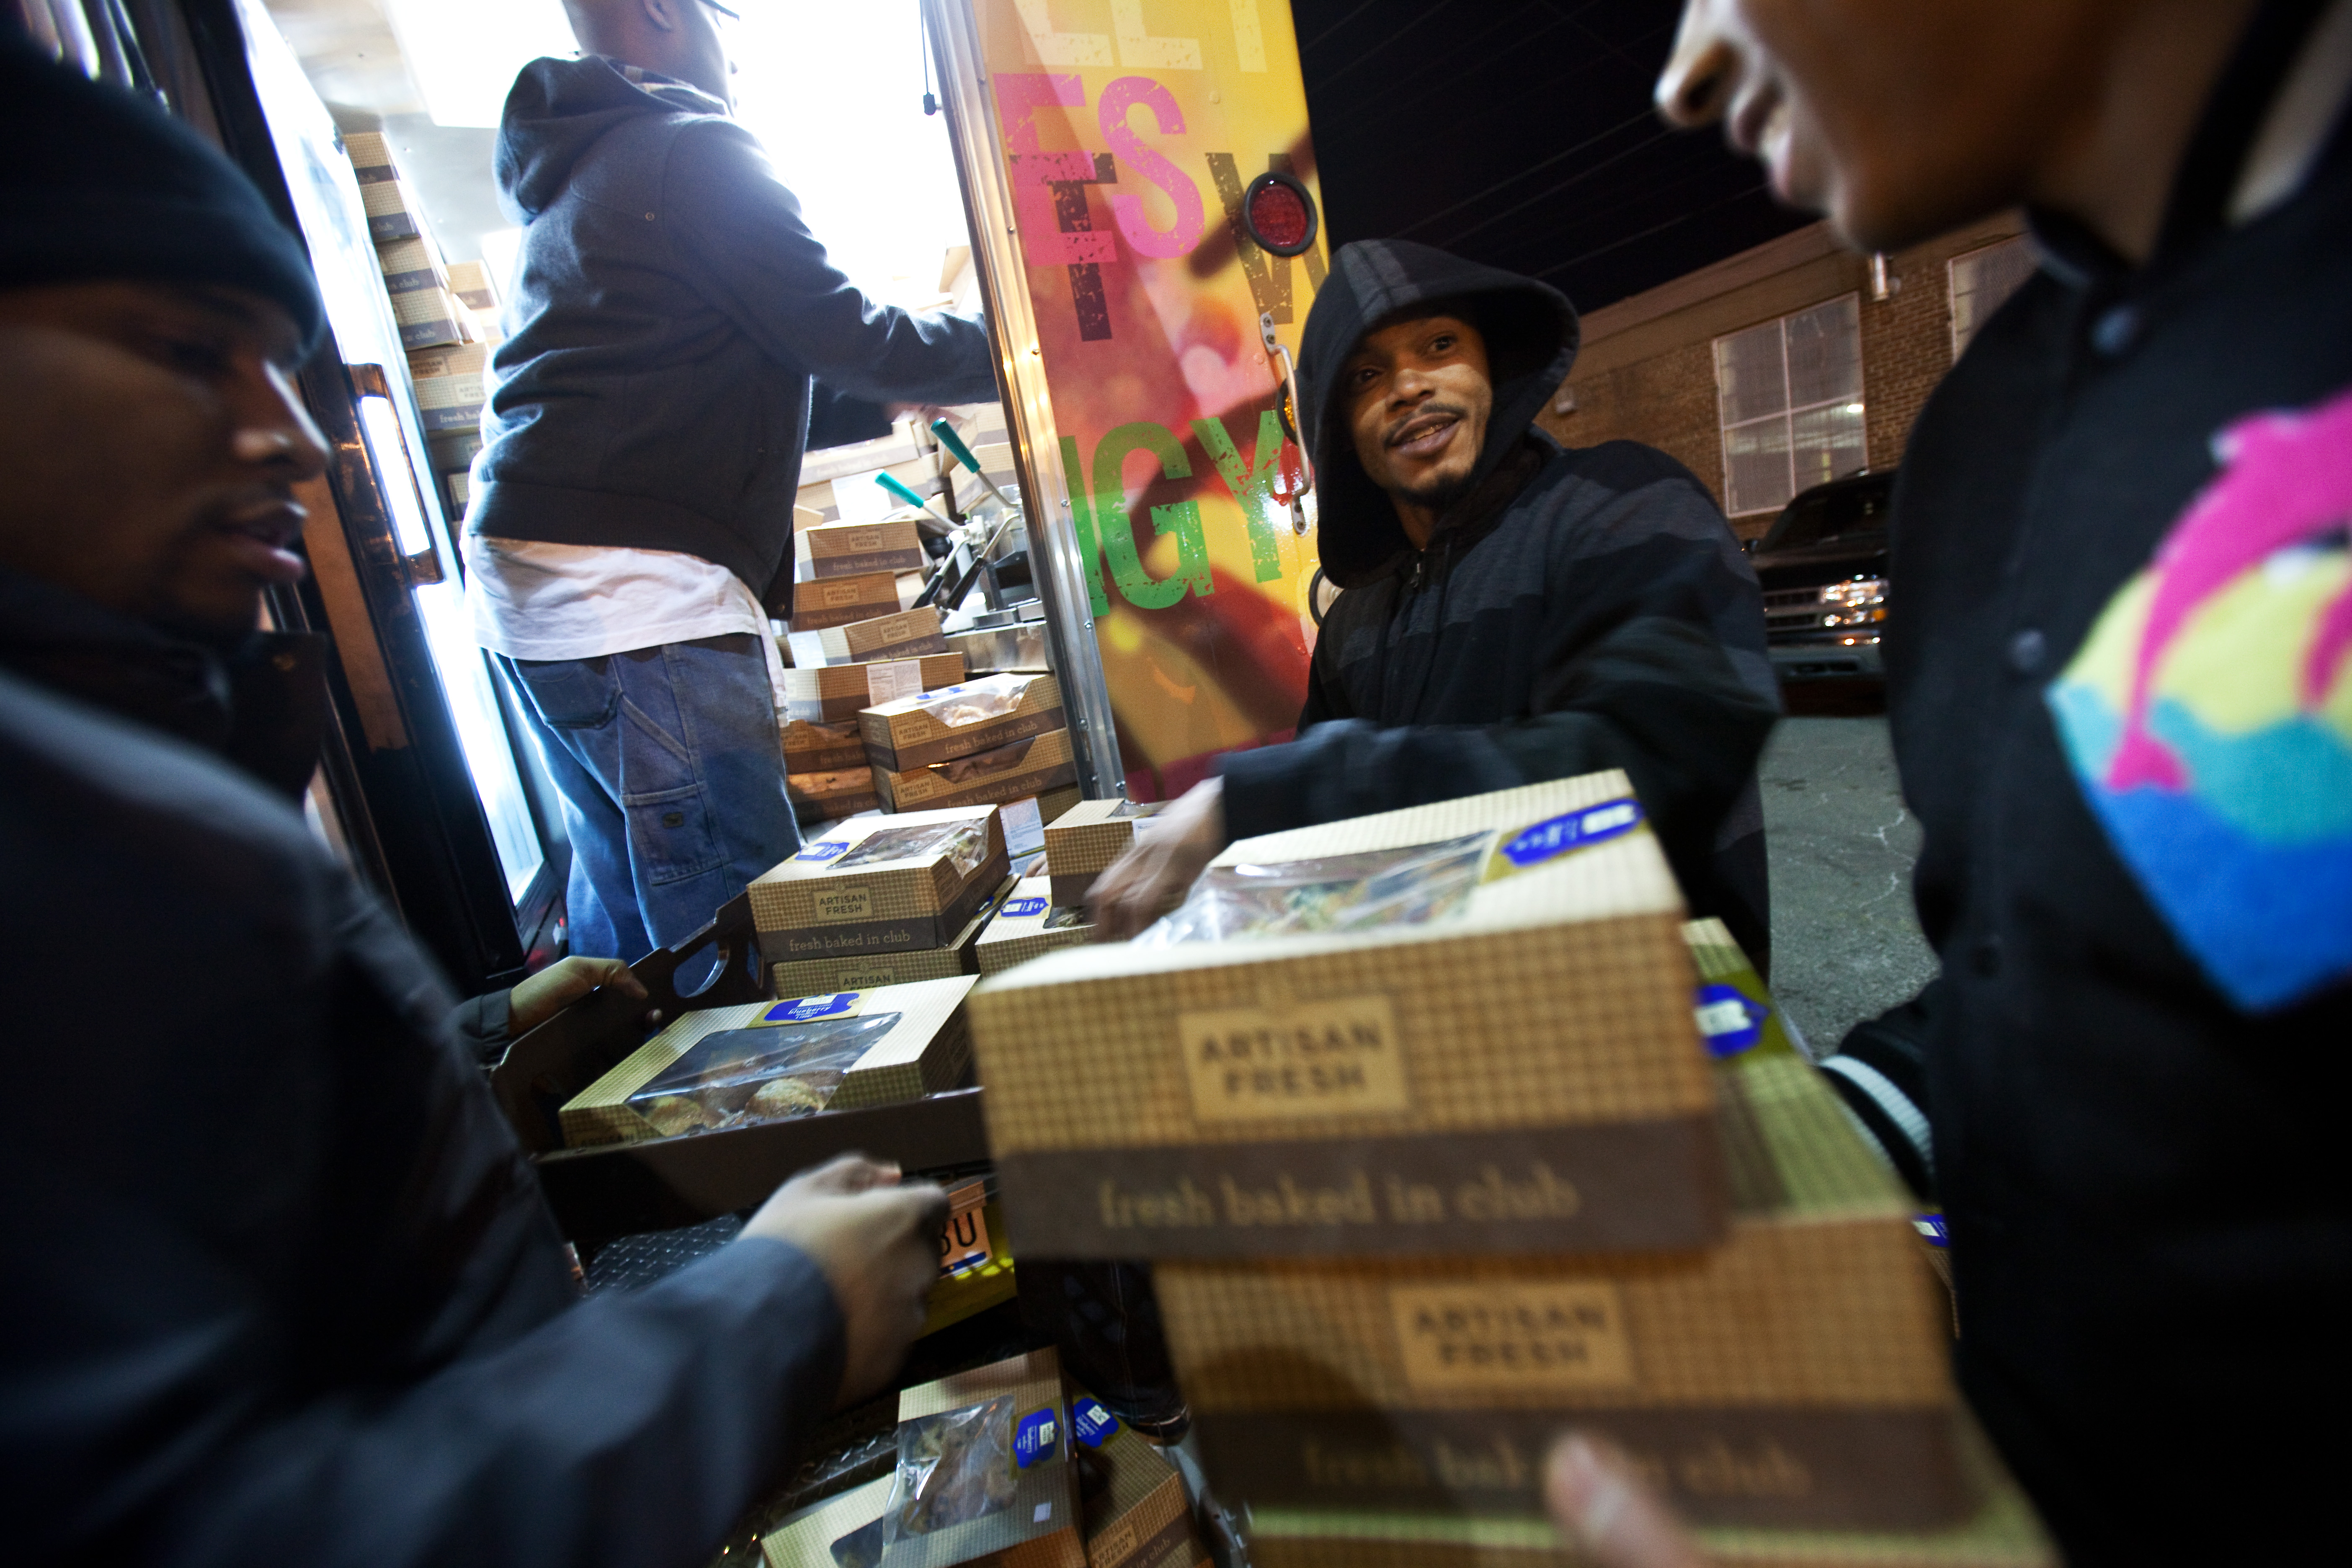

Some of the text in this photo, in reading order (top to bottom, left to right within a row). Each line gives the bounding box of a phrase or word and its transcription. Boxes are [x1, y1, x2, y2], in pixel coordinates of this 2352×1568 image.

[993, 73, 1205, 267] ES
[898, 723, 928, 735] ARTISAN
[902, 729, 927, 739] FRESH
[945, 721, 1038, 754] fresh baked in club
[900, 781, 931, 793] ARTISAN
[975, 788, 1006, 802] baked
[1008, 784, 1018, 794] in
[1019, 777, 1042, 791] club
[819, 893, 867, 907] ARTISAN
[826, 904, 862, 916] FRESH
[789, 929, 910, 952] fresh baked in club
[843, 974, 891, 987] ARTISAN
[1199, 1018, 1387, 1065] ARTISAN
[1224, 1062, 1371, 1099] FRESH
[1096, 1157, 1581, 1230] fresh baked in club
[1413, 1296, 1610, 1338] ARTISAN
[1437, 1335, 1592, 1371] FRESH
[1431, 1434, 1527, 1490] bak
[1149, 1537, 1171, 1561] club
